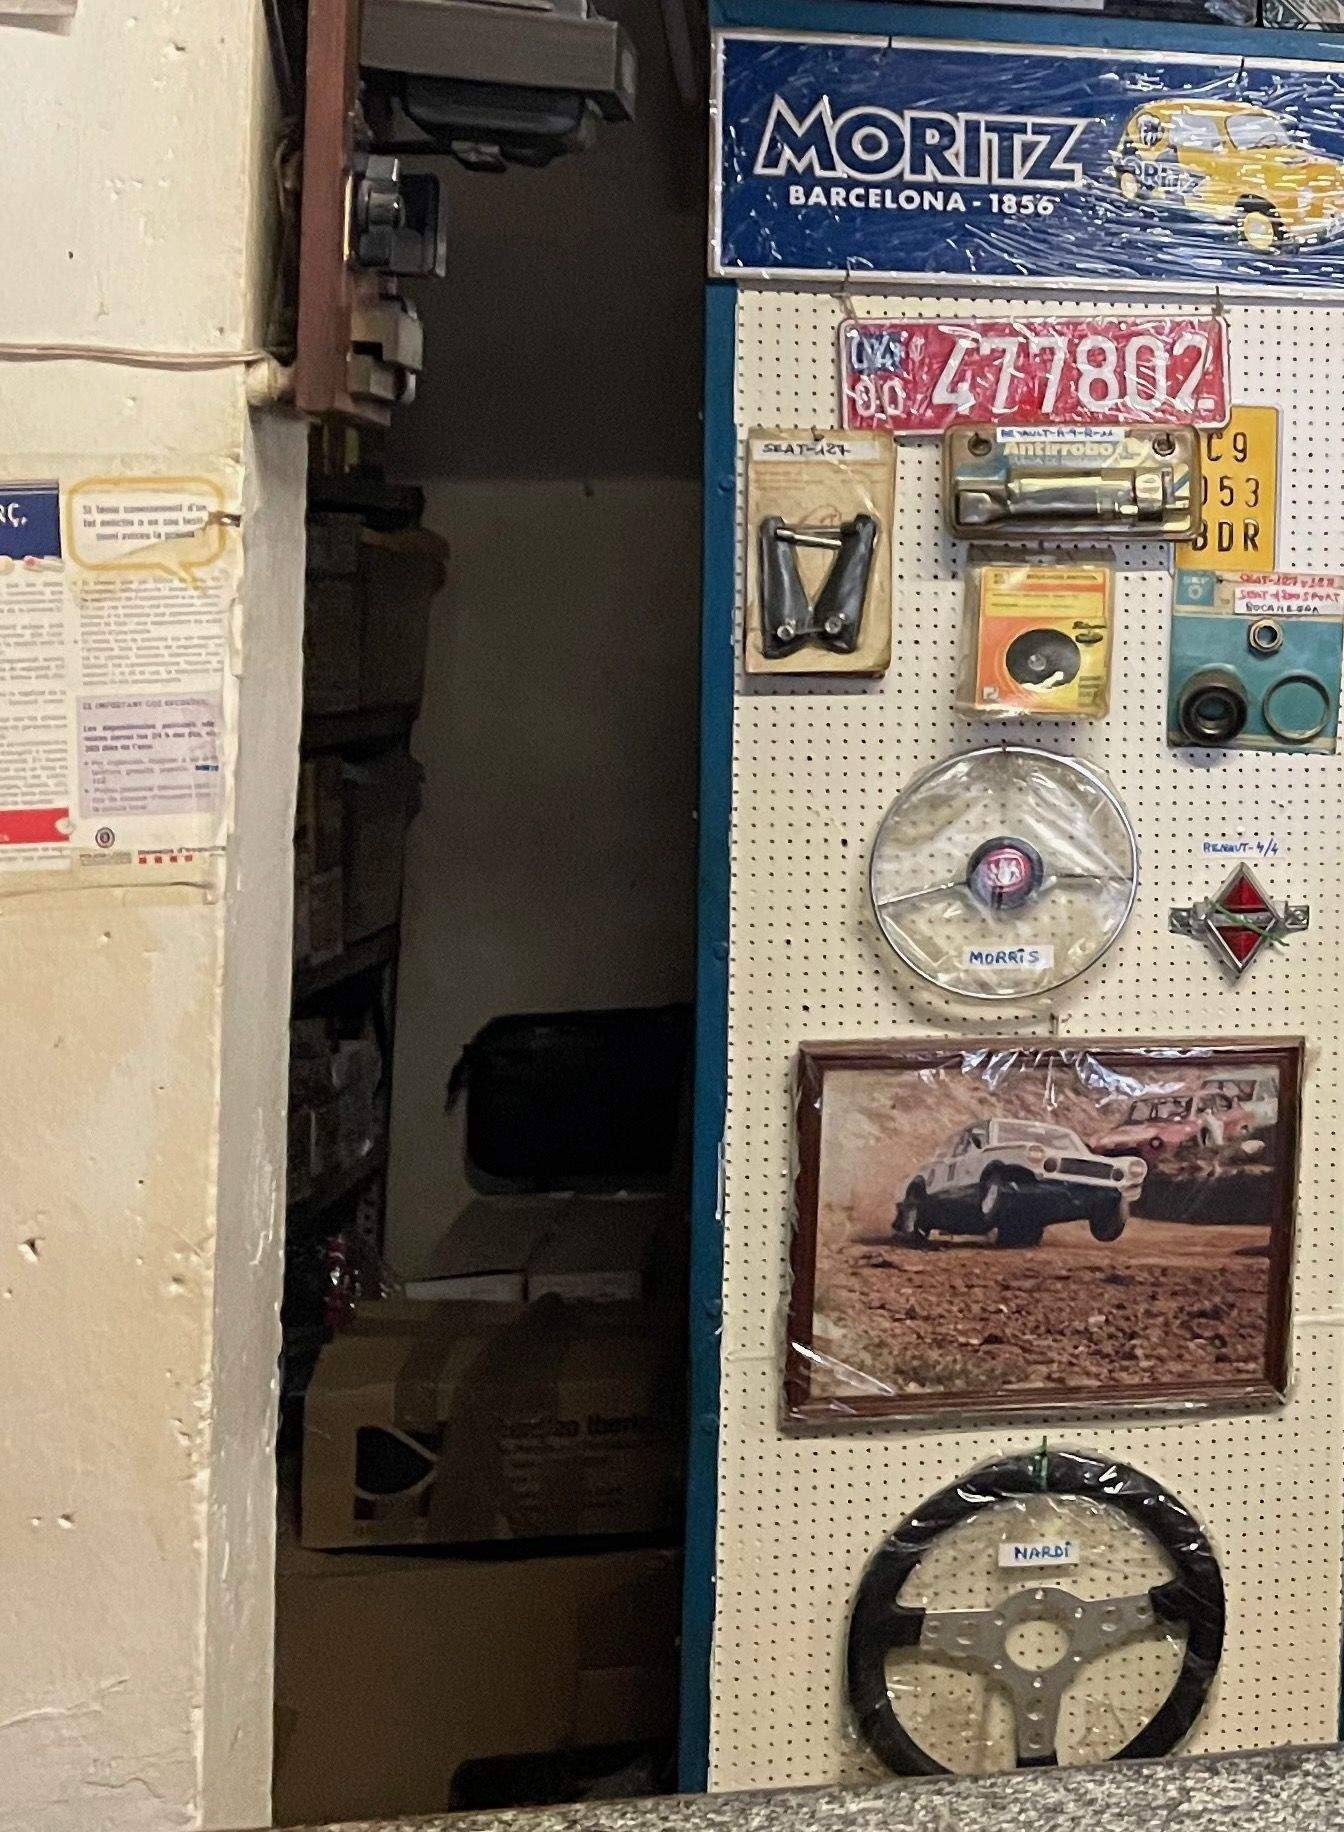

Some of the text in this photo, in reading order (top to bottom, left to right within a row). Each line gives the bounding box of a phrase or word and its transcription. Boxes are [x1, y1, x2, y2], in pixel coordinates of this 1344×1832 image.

[753, 94, 1099, 186] MORITZ
[789, 185, 1055, 216] BARCELONA 1856
[931, 330, 1216, 422] 477802
[1003, 441, 1114, 456] Antirrobo
[969, 948, 1040, 965] MORRIS
[1014, 1541, 1073, 1560] NARDI
